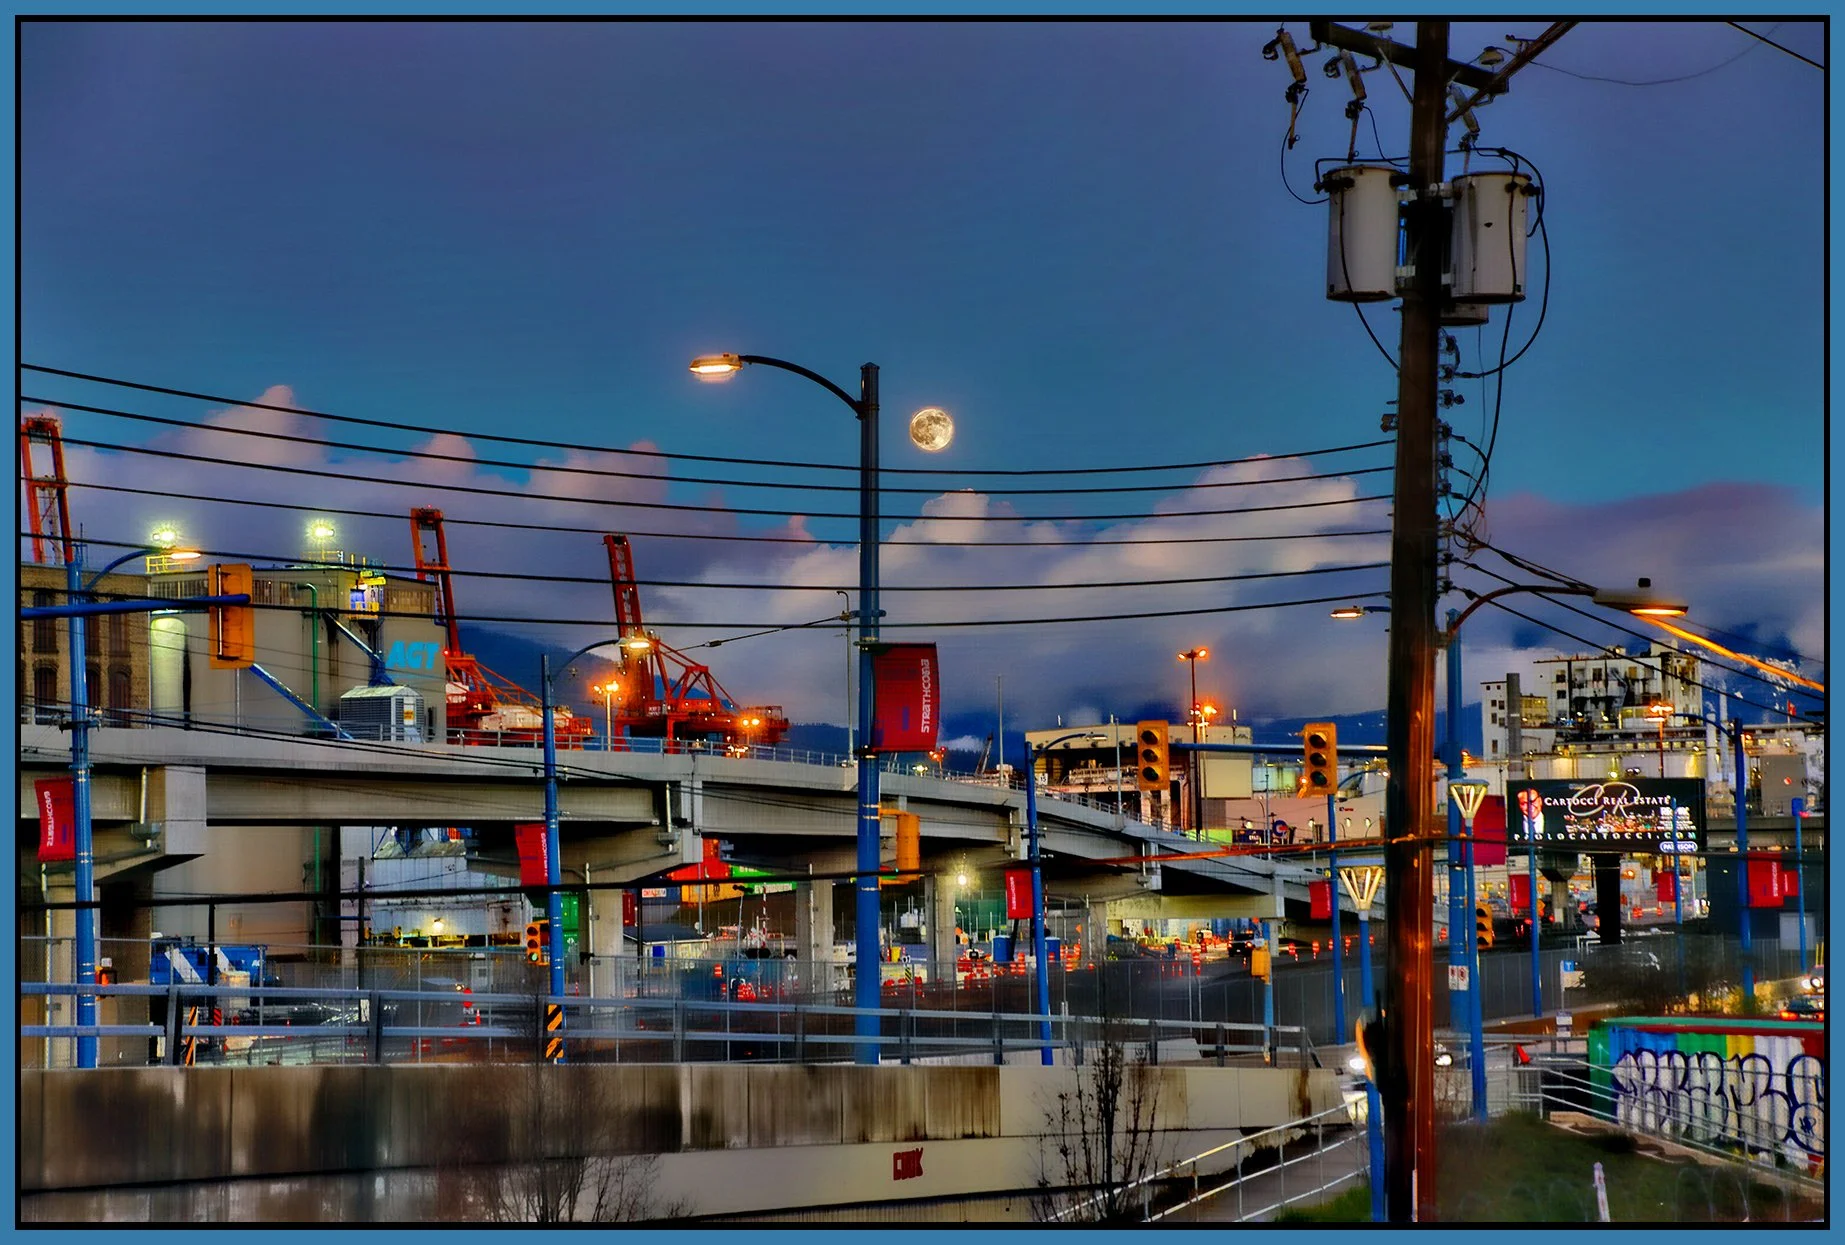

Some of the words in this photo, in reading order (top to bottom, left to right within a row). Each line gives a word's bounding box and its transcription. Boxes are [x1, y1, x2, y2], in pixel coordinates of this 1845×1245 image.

[385, 640, 439, 670] AGT
[1603, 797, 1628, 805] REAL
[1633, 796, 1670, 805] ESTATE
[1663, 842, 1695, 851] PAISON
